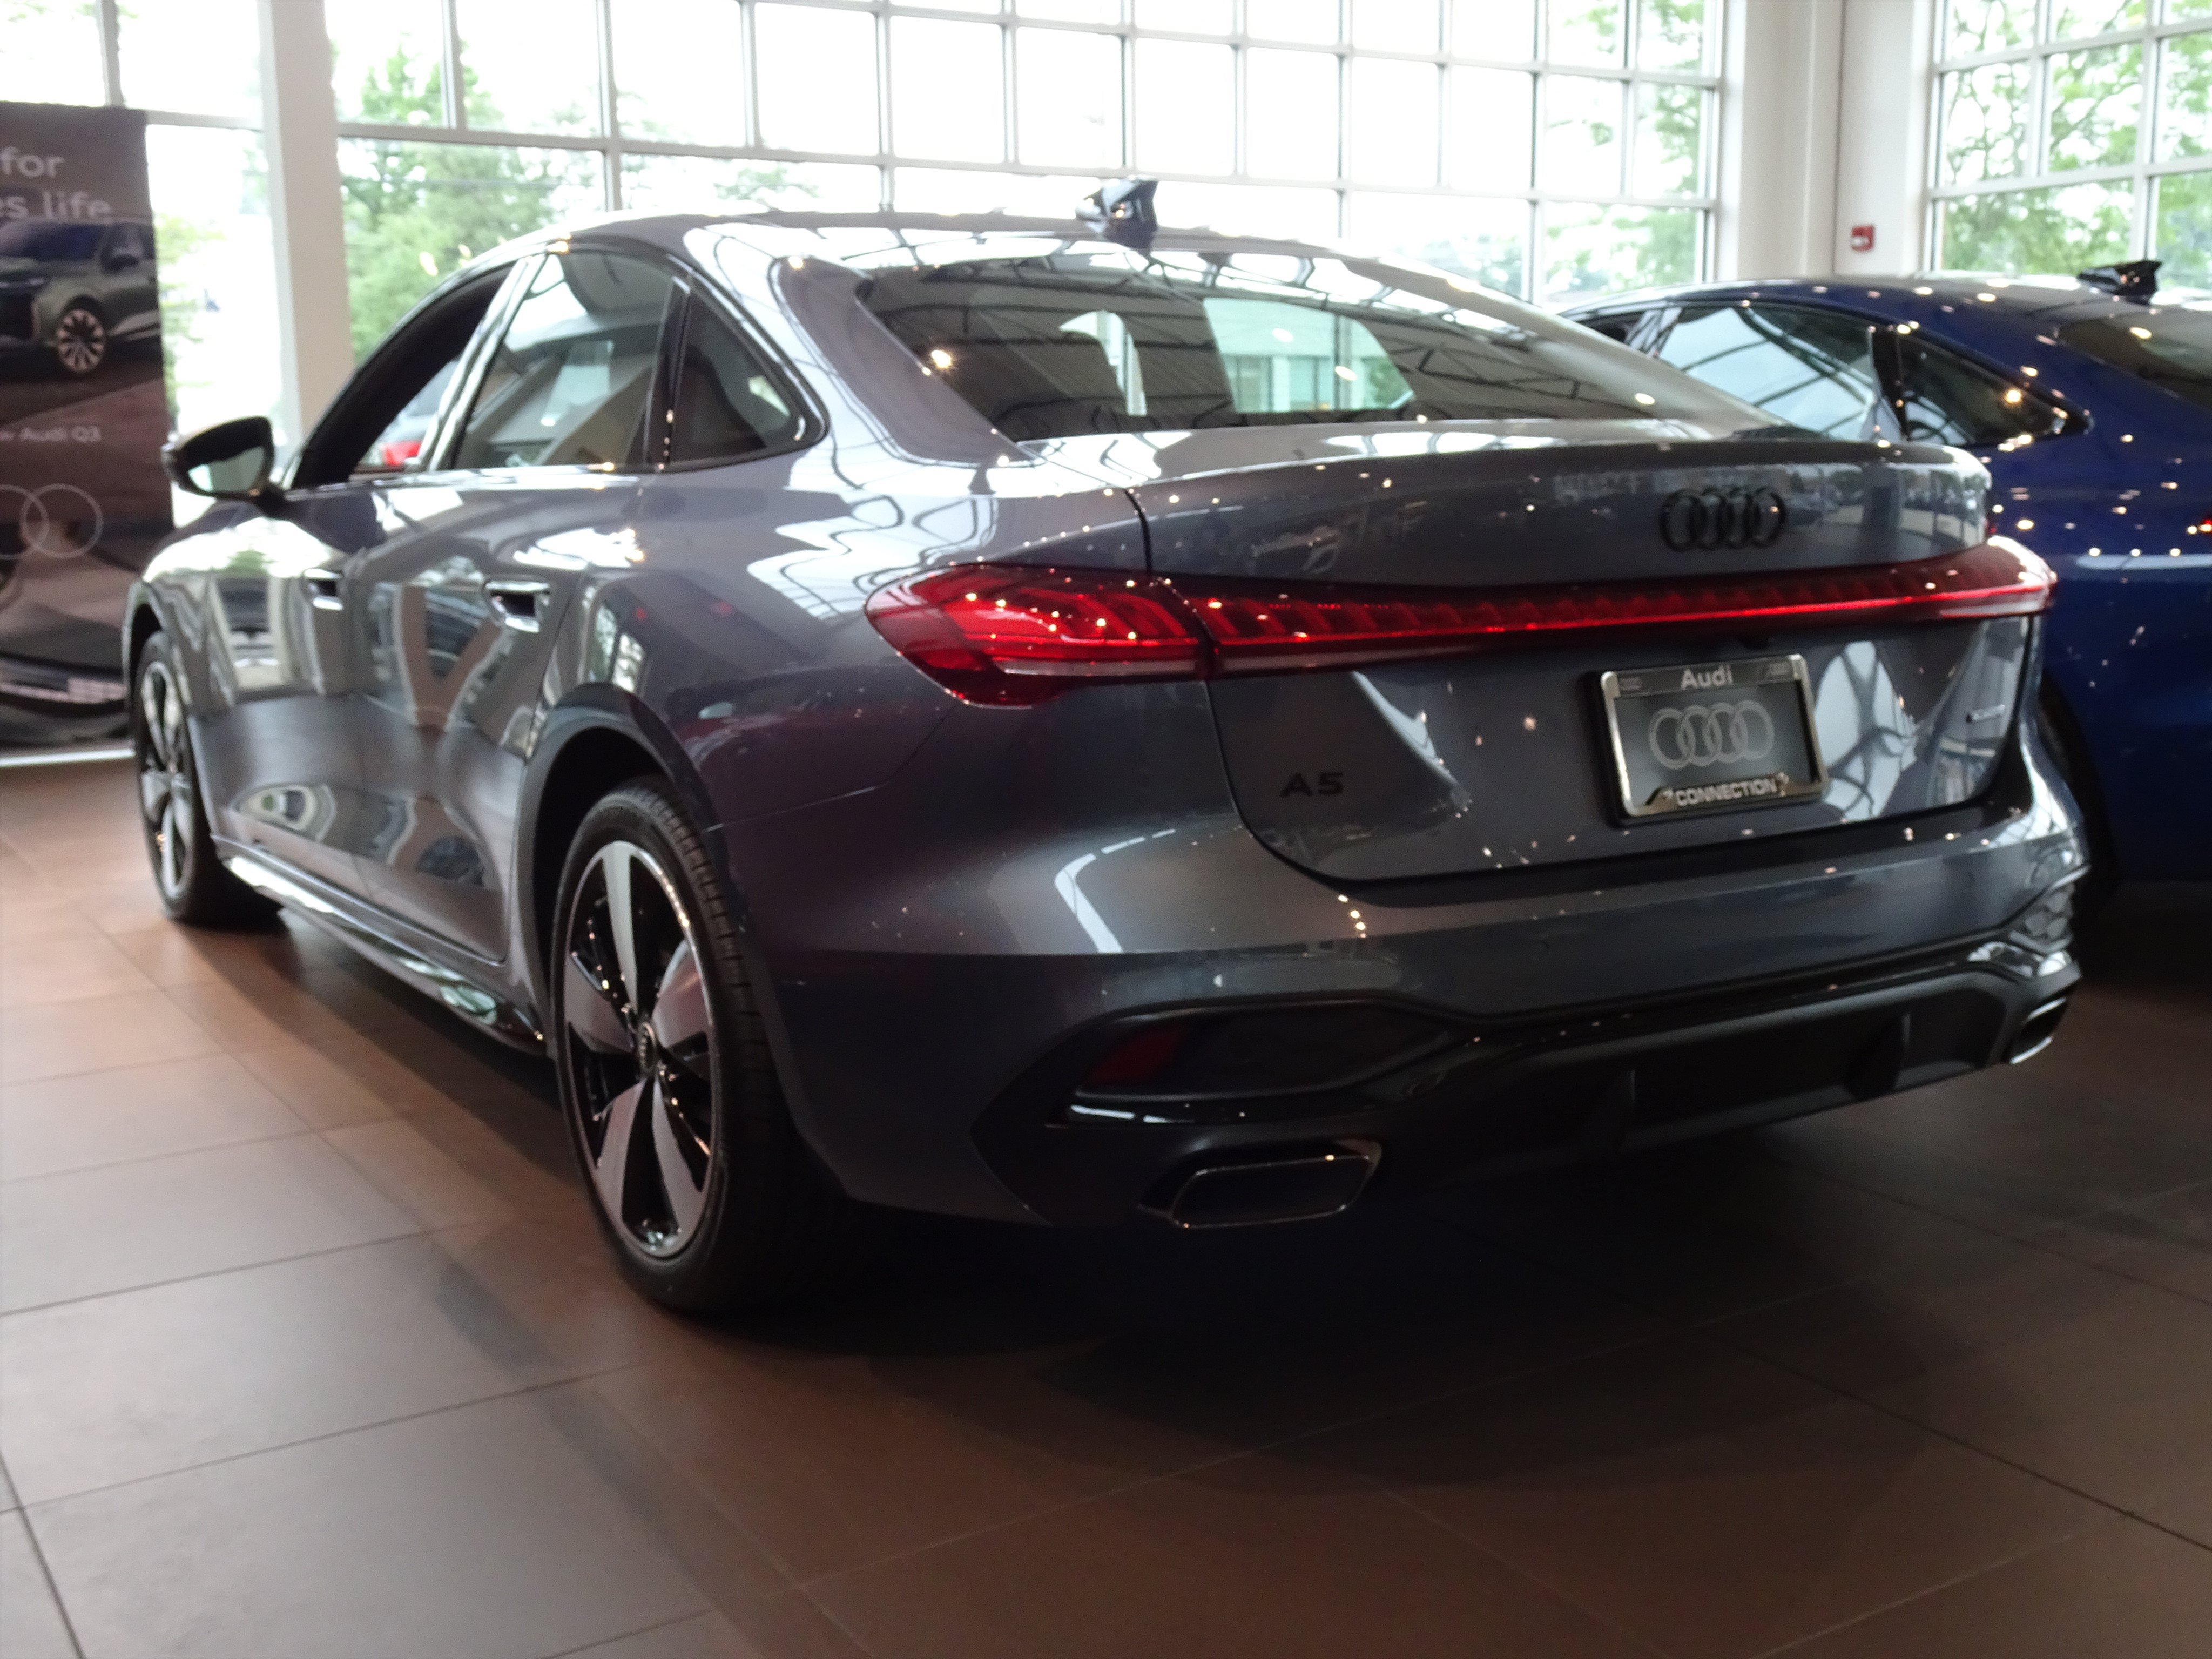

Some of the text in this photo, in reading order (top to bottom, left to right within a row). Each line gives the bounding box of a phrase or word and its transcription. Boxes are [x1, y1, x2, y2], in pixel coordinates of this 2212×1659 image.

[0, 146, 65, 178] for
[1680, 664, 1733, 691] Audi
[1280, 772, 1344, 798] A5
[1675, 778, 1777, 807] CONNECTION
